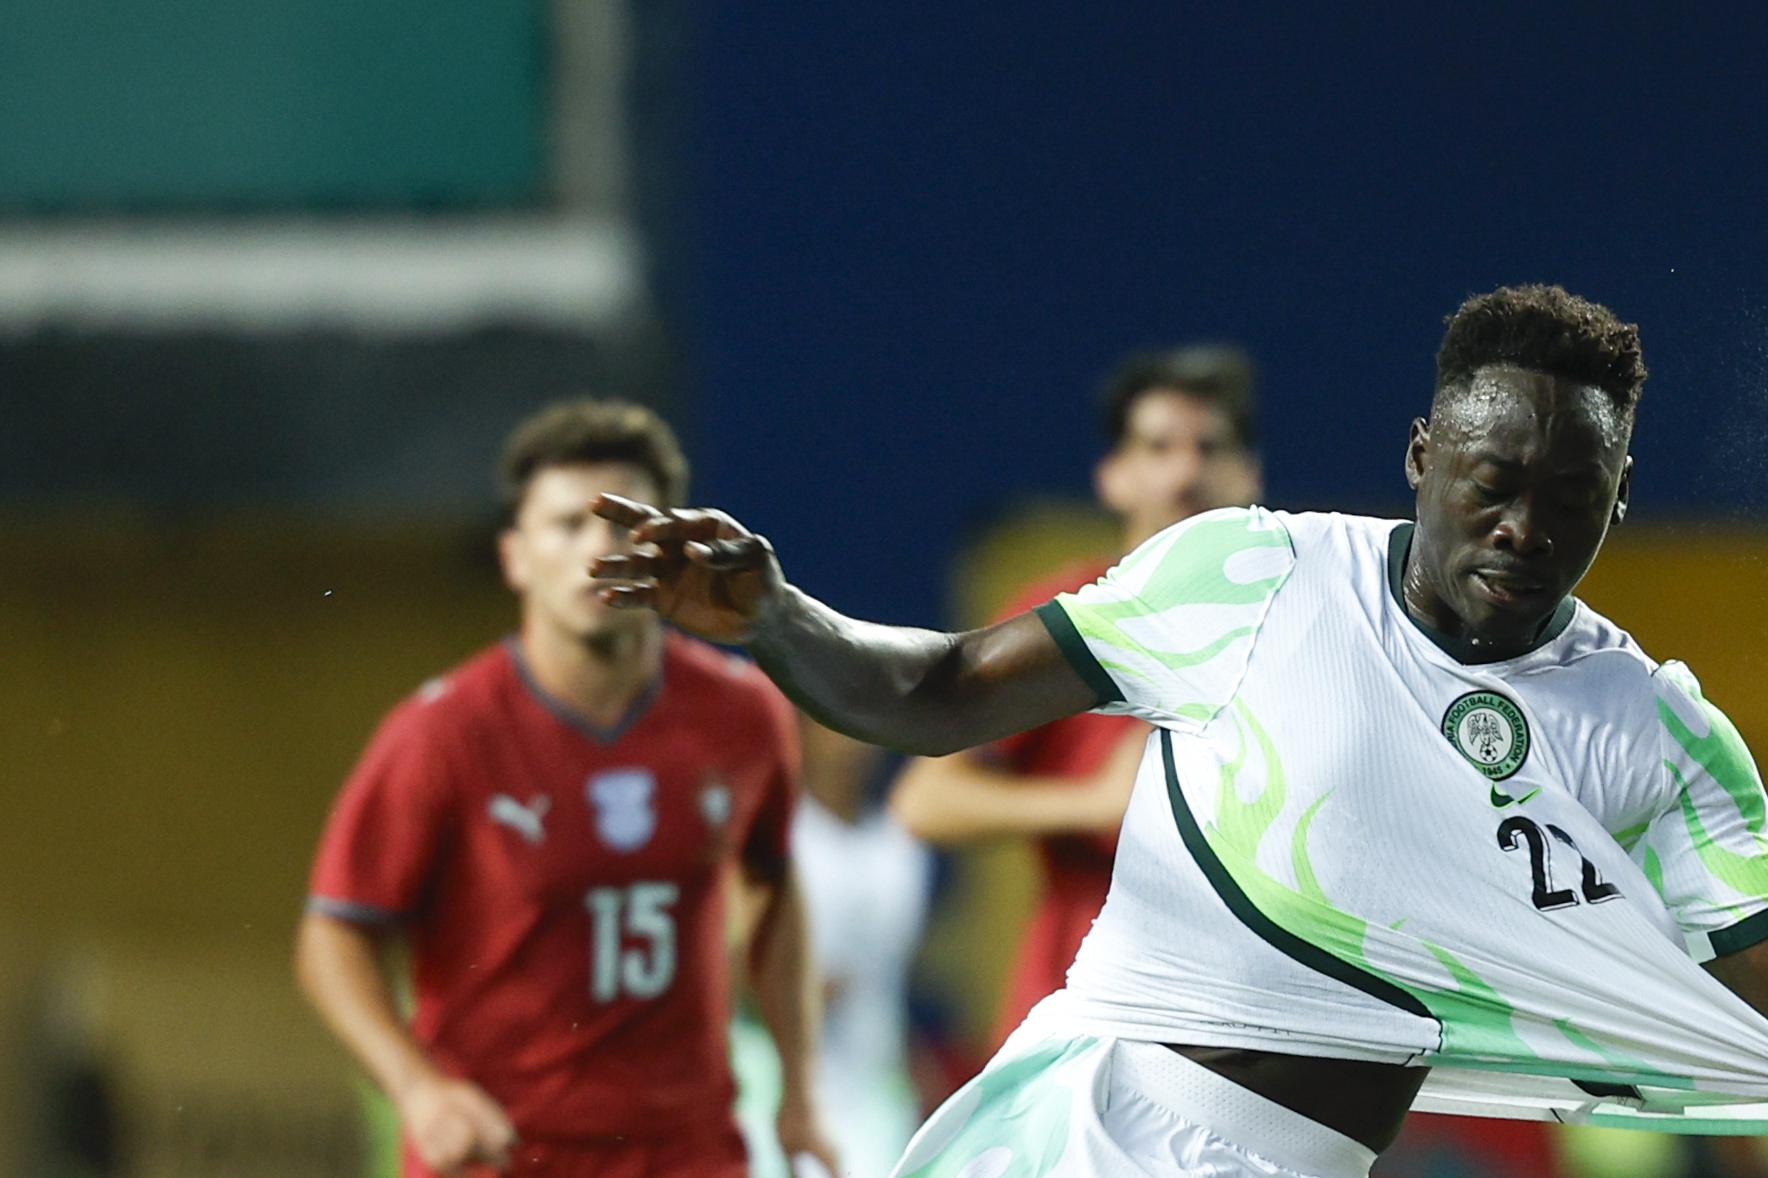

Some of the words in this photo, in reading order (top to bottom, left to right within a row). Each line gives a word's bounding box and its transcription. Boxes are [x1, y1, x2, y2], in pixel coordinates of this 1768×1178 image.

[1448, 695, 1496, 724] FOOTBALL
[1496, 700, 1525, 764] FEDERATION
[586, 881, 679, 1003] 15
